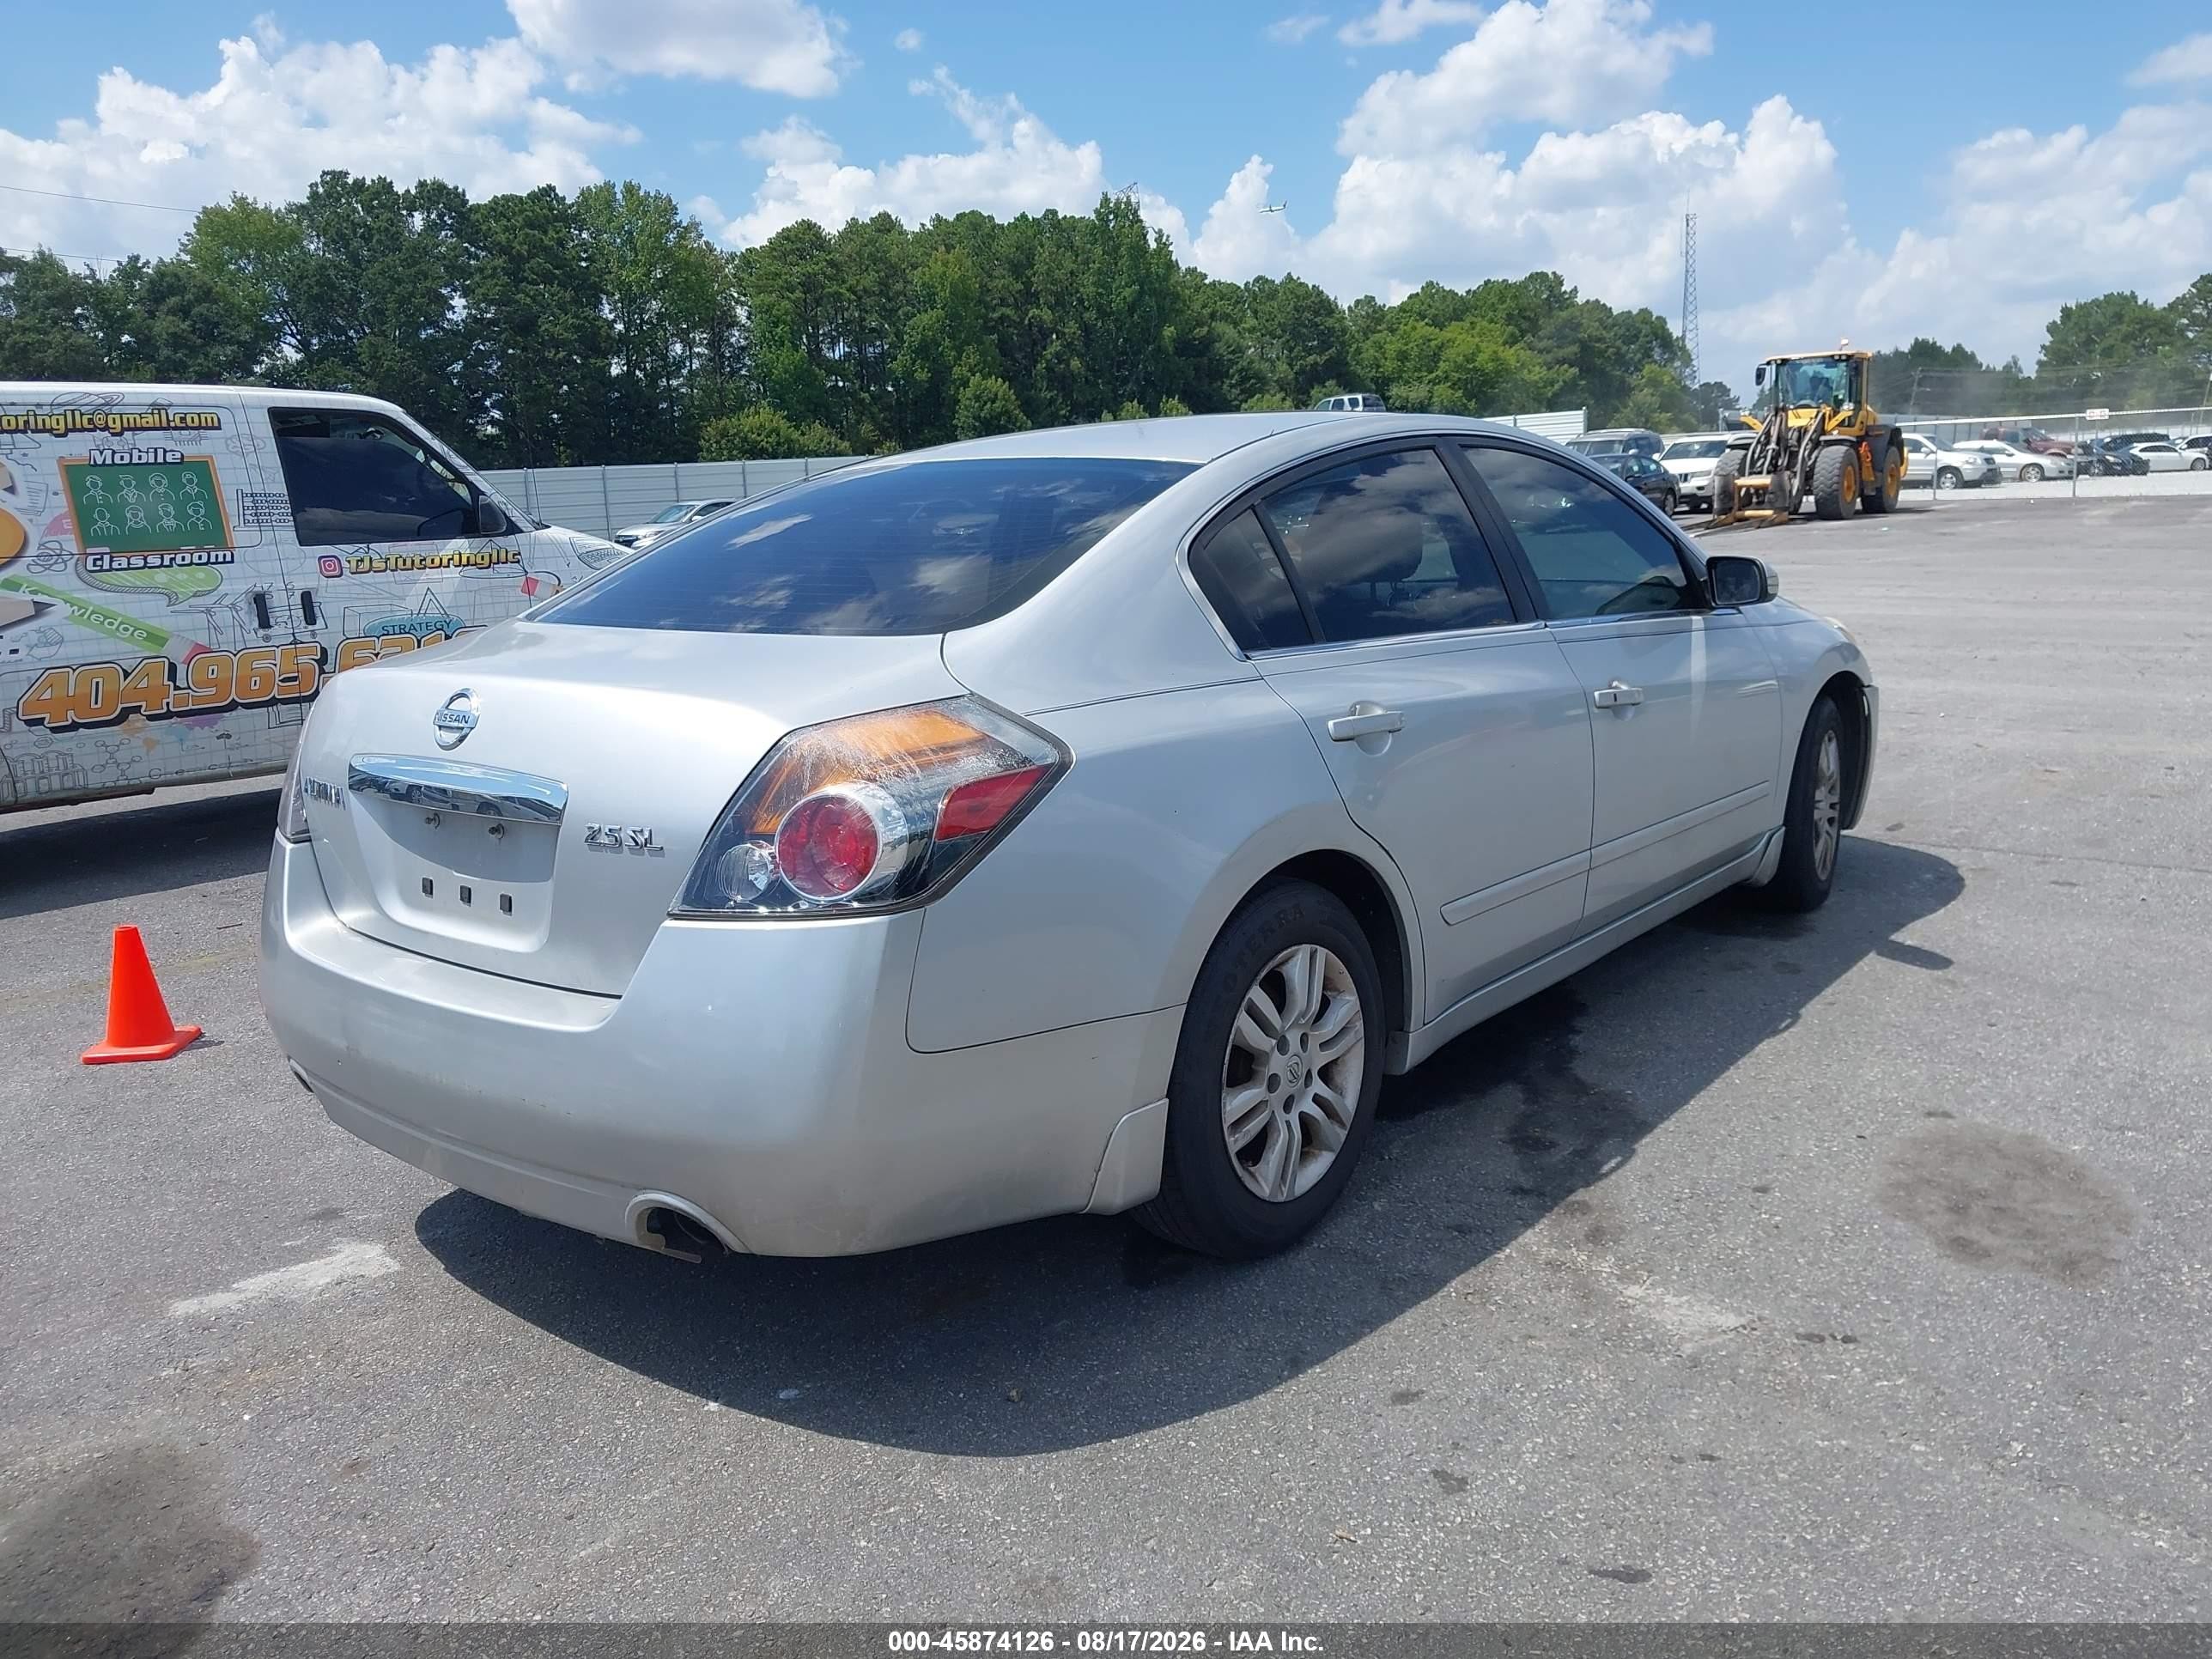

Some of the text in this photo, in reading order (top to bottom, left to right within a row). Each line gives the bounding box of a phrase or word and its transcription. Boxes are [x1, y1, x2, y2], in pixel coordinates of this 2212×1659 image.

[0, 410, 221, 435] oringllc@gmail.com
[88, 447, 183, 465] Mobile
[86, 550, 233, 571] Classroom
[346, 548, 521, 574] TJsTutoringllc
[381, 619, 452, 635] STRATEGY
[434, 712, 471, 724] NISSAN
[624, 826, 664, 851] SL
